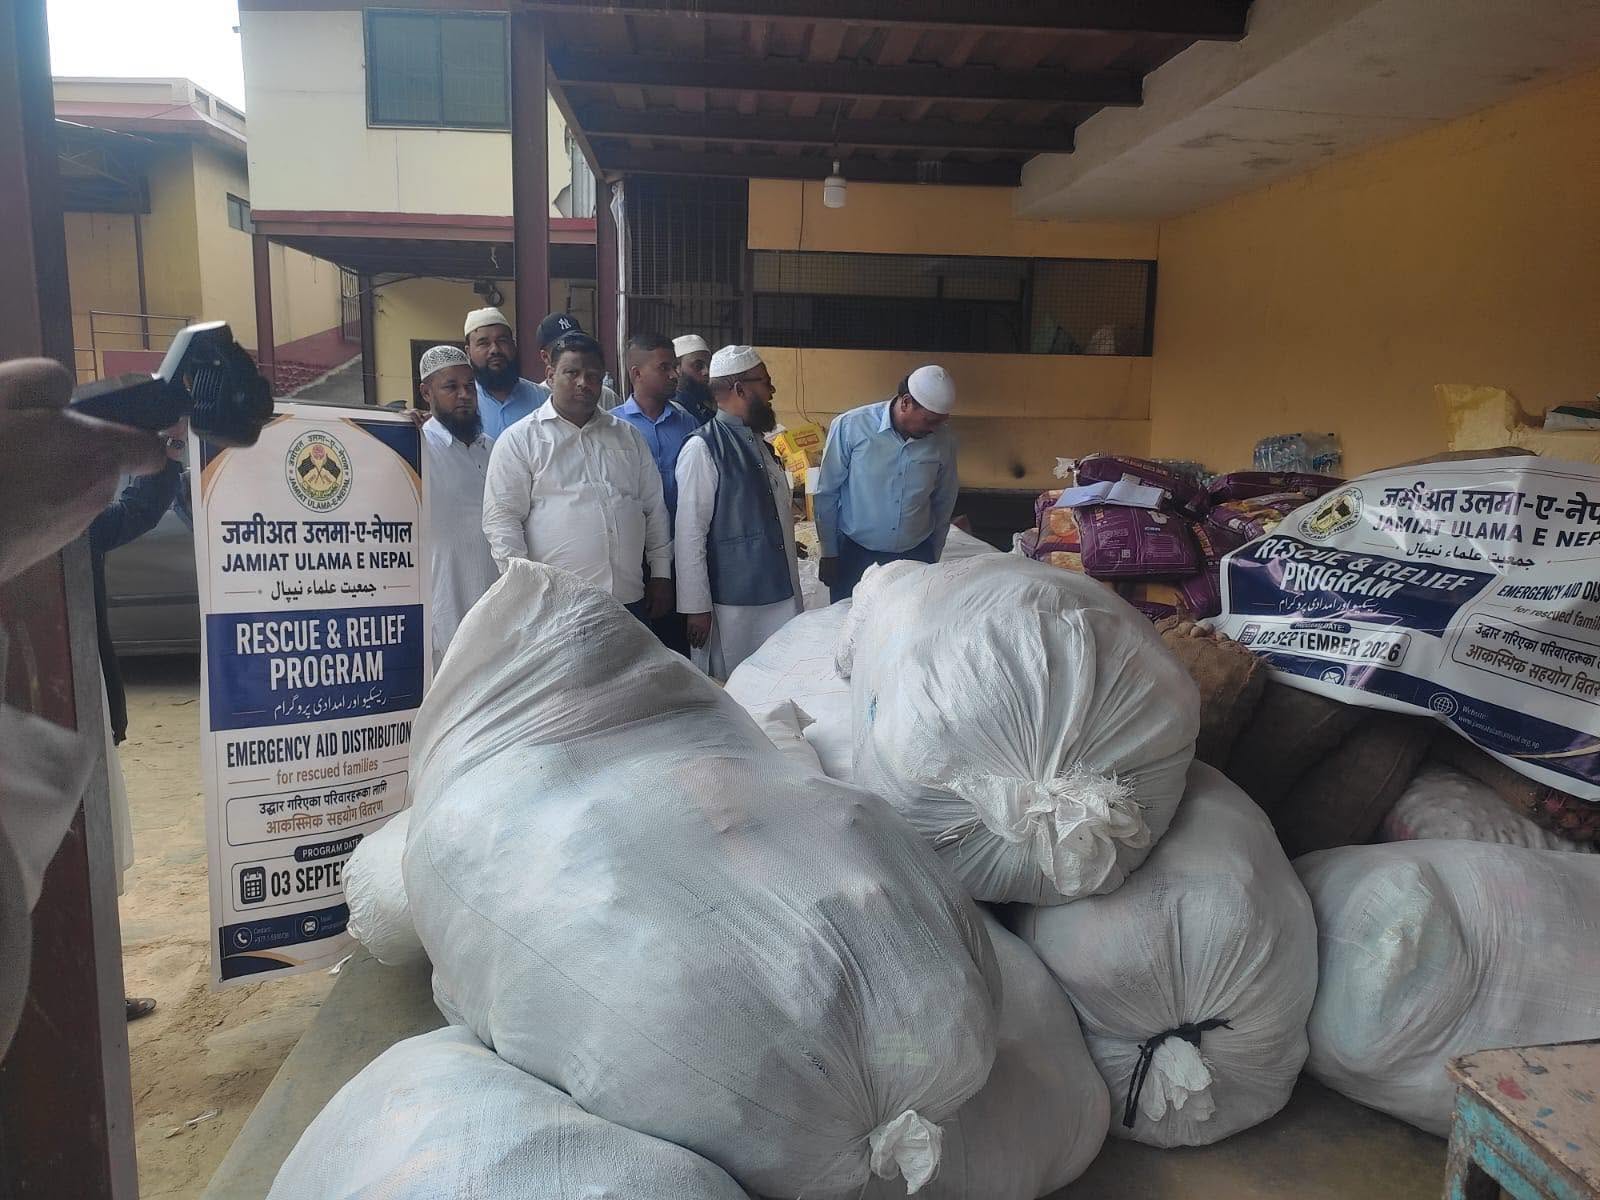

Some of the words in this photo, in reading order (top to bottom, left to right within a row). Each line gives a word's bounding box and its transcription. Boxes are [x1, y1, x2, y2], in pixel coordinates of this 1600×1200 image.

[289, 476, 307, 502] JAMIAT
[308, 479, 350, 509] ULAMA-E-NEPAL
[221, 513, 297, 544] जमीअत
[302, 514, 412, 544] उलमा-ए-नेपाल
[1373, 515, 1445, 536] JAMIAT
[1451, 520, 1523, 543] ULAMA
[1532, 528, 1548, 546] E
[1555, 530, 1600, 547] NEP
[222, 553, 289, 573] JAMIAT
[296, 552, 352, 571] ULAMA
[357, 552, 365, 569] E
[370, 551, 414, 569] NEPAL
[1254, 538, 1352, 567] RESCUE
[1348, 557, 1374, 571] &
[1374, 561, 1475, 592] RELIEF
[1280, 562, 1403, 599] PROGRAM
[1497, 585, 1566, 601] EMERGENCY
[1562, 582, 1583, 598] AID
[1513, 606, 1530, 614] for
[1530, 610, 1573, 624] rescued
[236, 620, 321, 655] RESCUE
[327, 619, 341, 649] &
[346, 615, 406, 648] RELIEF
[1257, 631, 1274, 645] 03
[1272, 631, 1360, 657] SEPTEMBER
[1361, 641, 1401, 662] 2026
[1475, 622, 1502, 640] उद्धार
[1502, 630, 1539, 652] गरिएका
[270, 650, 384, 691] PROGRAM
[1466, 644, 1528, 674] आकस्मिक
[1529, 664, 1572, 688] सहयोग
[227, 735, 311, 768] EMERGENCY
[316, 733, 337, 758] AID
[342, 721, 412, 755] DISTRIBUTION
[276, 769, 294, 785] for
[297, 764, 340, 782] rescued
[343, 759, 379, 775] families
[259, 800, 285, 816] उद्धार
[287, 794, 321, 810] गरिएका
[373, 780, 388, 794] लागि
[266, 813, 323, 834] आकस्मिक
[327, 804, 358, 825] सहयोग
[359, 800, 384, 817] वितरण
[303, 843, 342, 858] PROGRAM
[271, 870, 291, 897] 03
[296, 859, 348, 893] SEPTE
